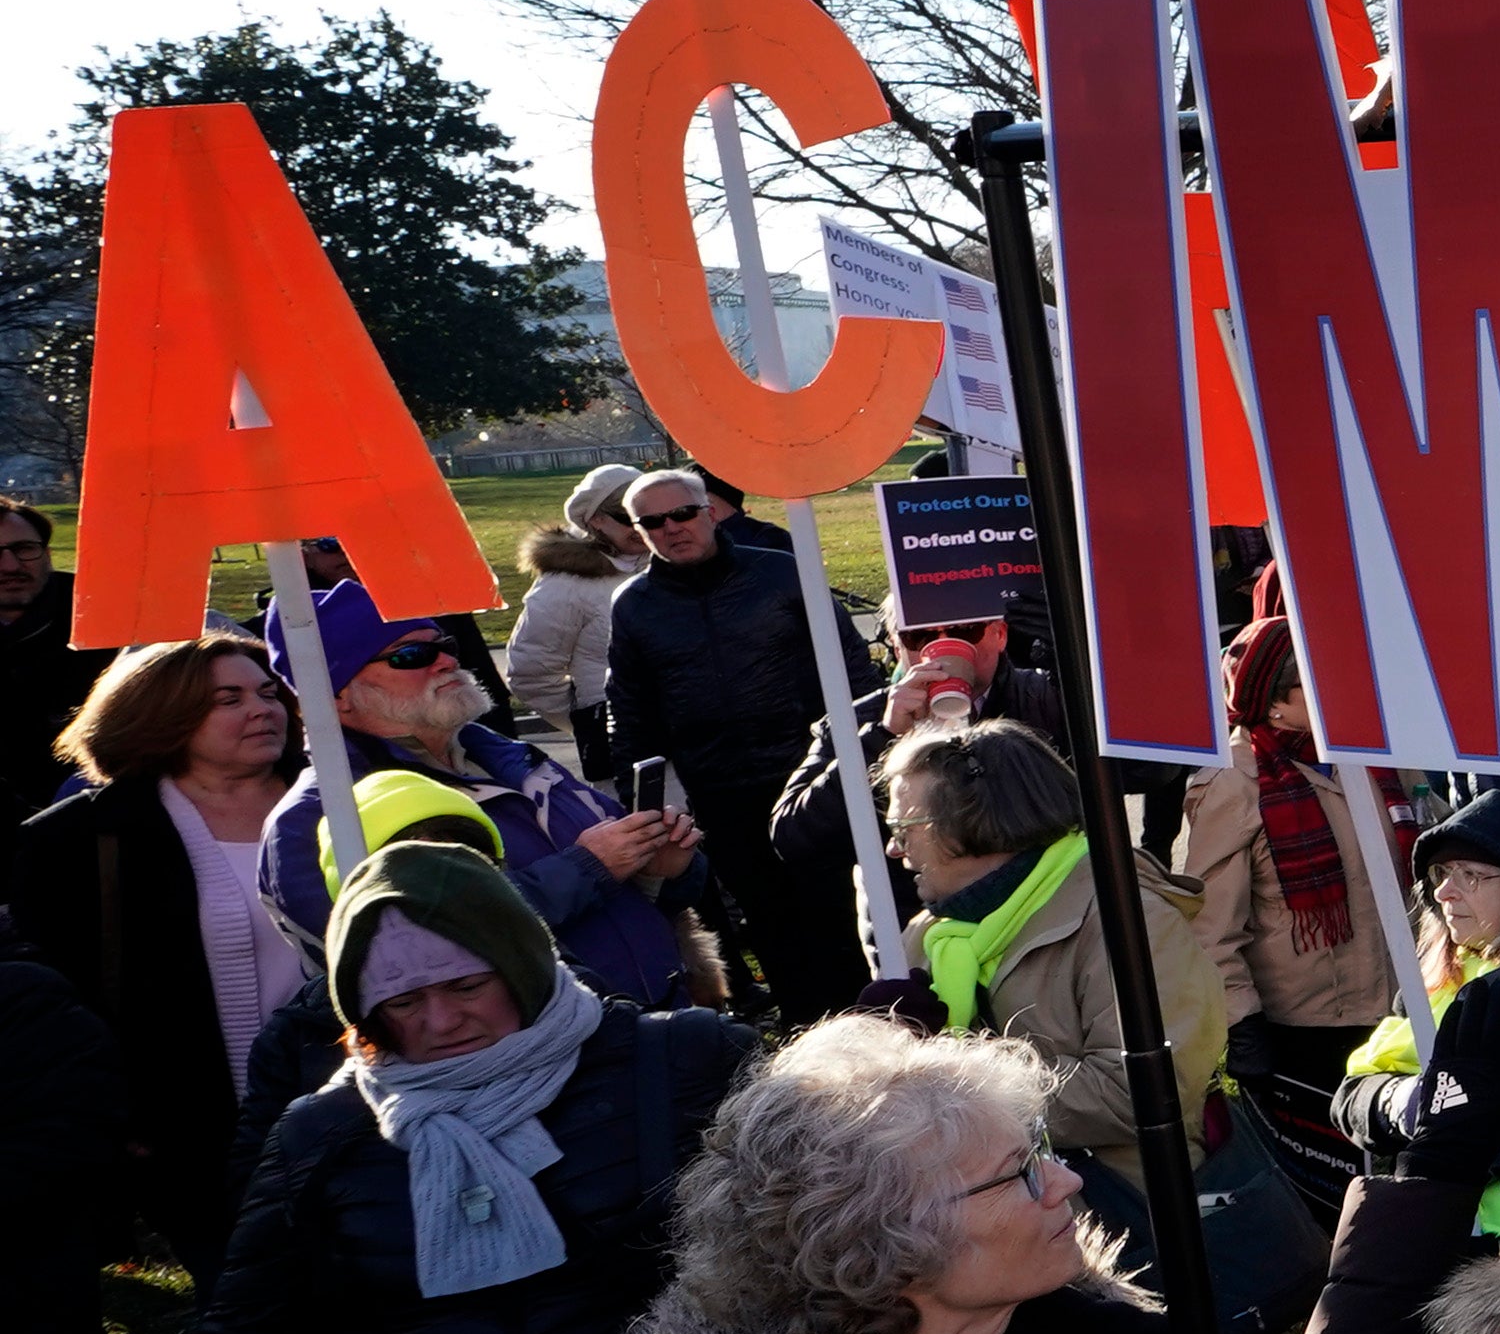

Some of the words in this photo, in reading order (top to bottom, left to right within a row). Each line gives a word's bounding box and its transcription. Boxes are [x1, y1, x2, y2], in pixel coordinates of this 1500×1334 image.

[826, 225, 904, 267] Members
[908, 259, 924, 275] of
[830, 253, 911, 294] Congress:
[835, 282, 891, 313] Honor
[897, 496, 972, 515] Protect
[975, 494, 1011, 509] Our
[902, 530, 976, 550] Defend
[979, 527, 1016, 542] Our
[908, 563, 994, 585] Impeach
